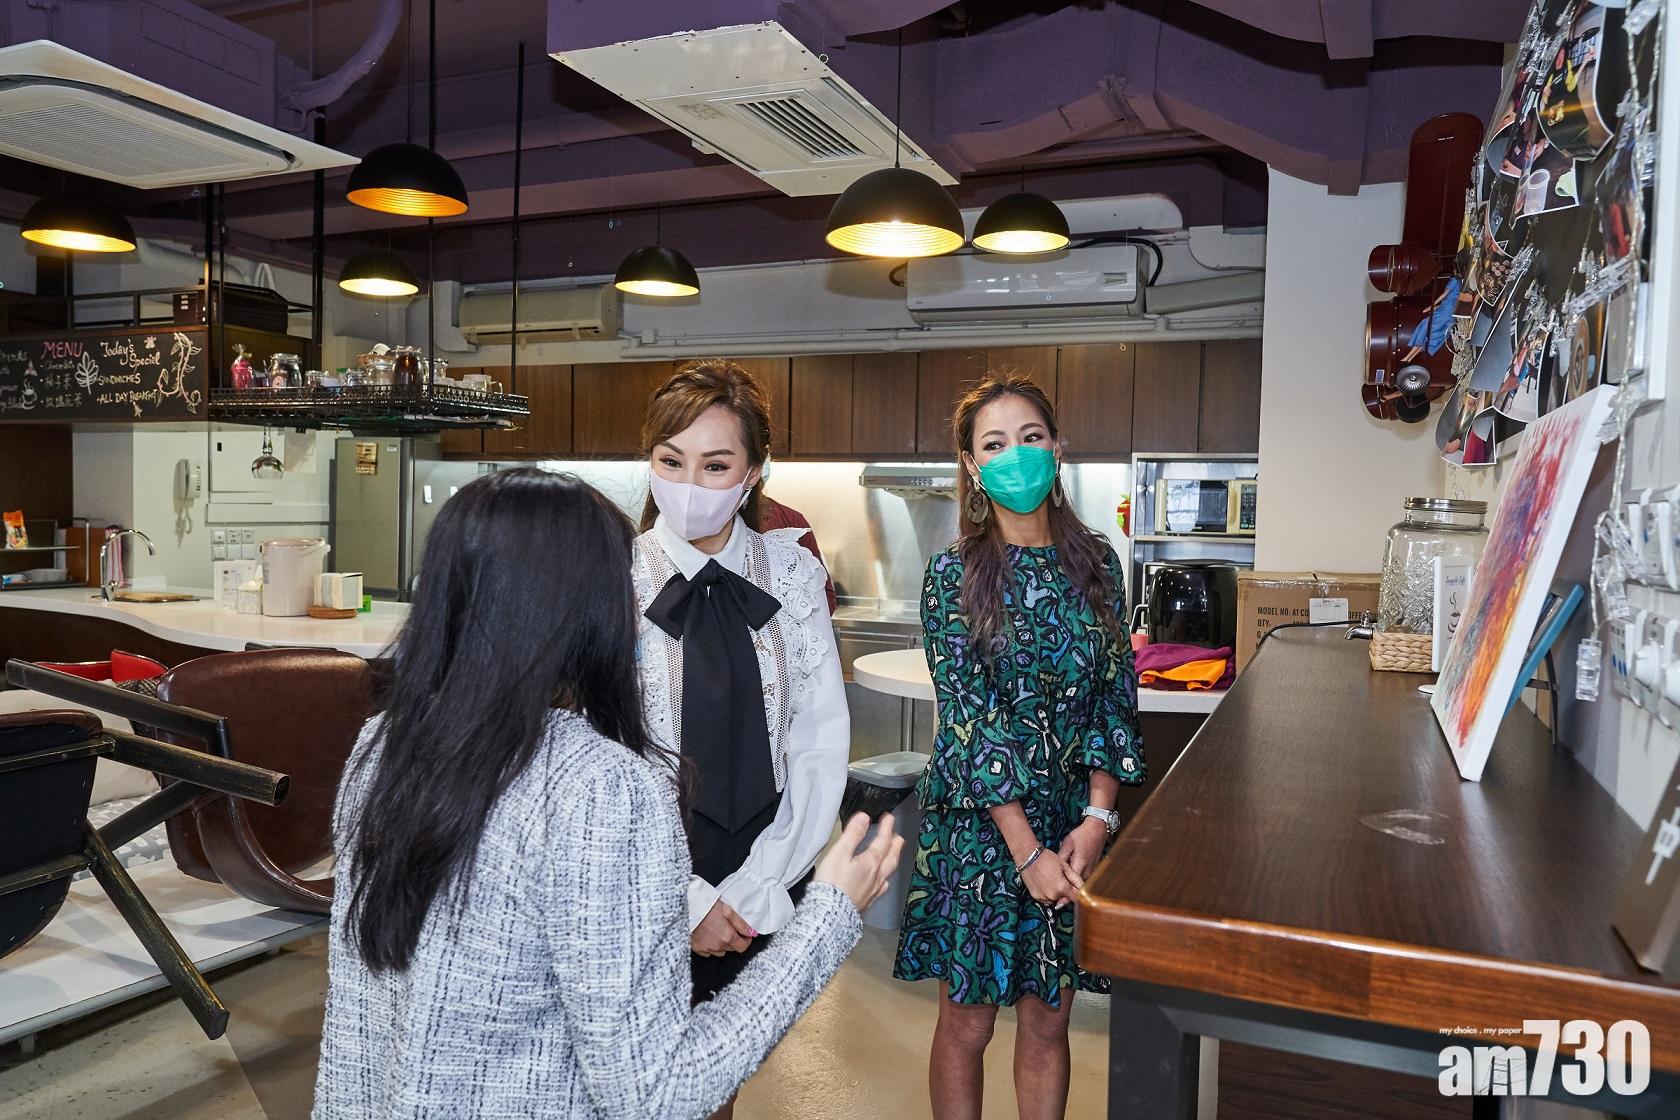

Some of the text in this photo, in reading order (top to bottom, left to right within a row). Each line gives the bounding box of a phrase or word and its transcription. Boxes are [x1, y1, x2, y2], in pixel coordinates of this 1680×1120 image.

[40, 341, 84, 360] MENU
[100, 338, 135, 366] Today's
[129, 351, 161, 372] Special
[99, 393, 113, 405] ALL
[115, 392, 129, 404] DAY
[1257, 606, 1278, 616] MODEL
[1300, 609, 1309, 617] CO
